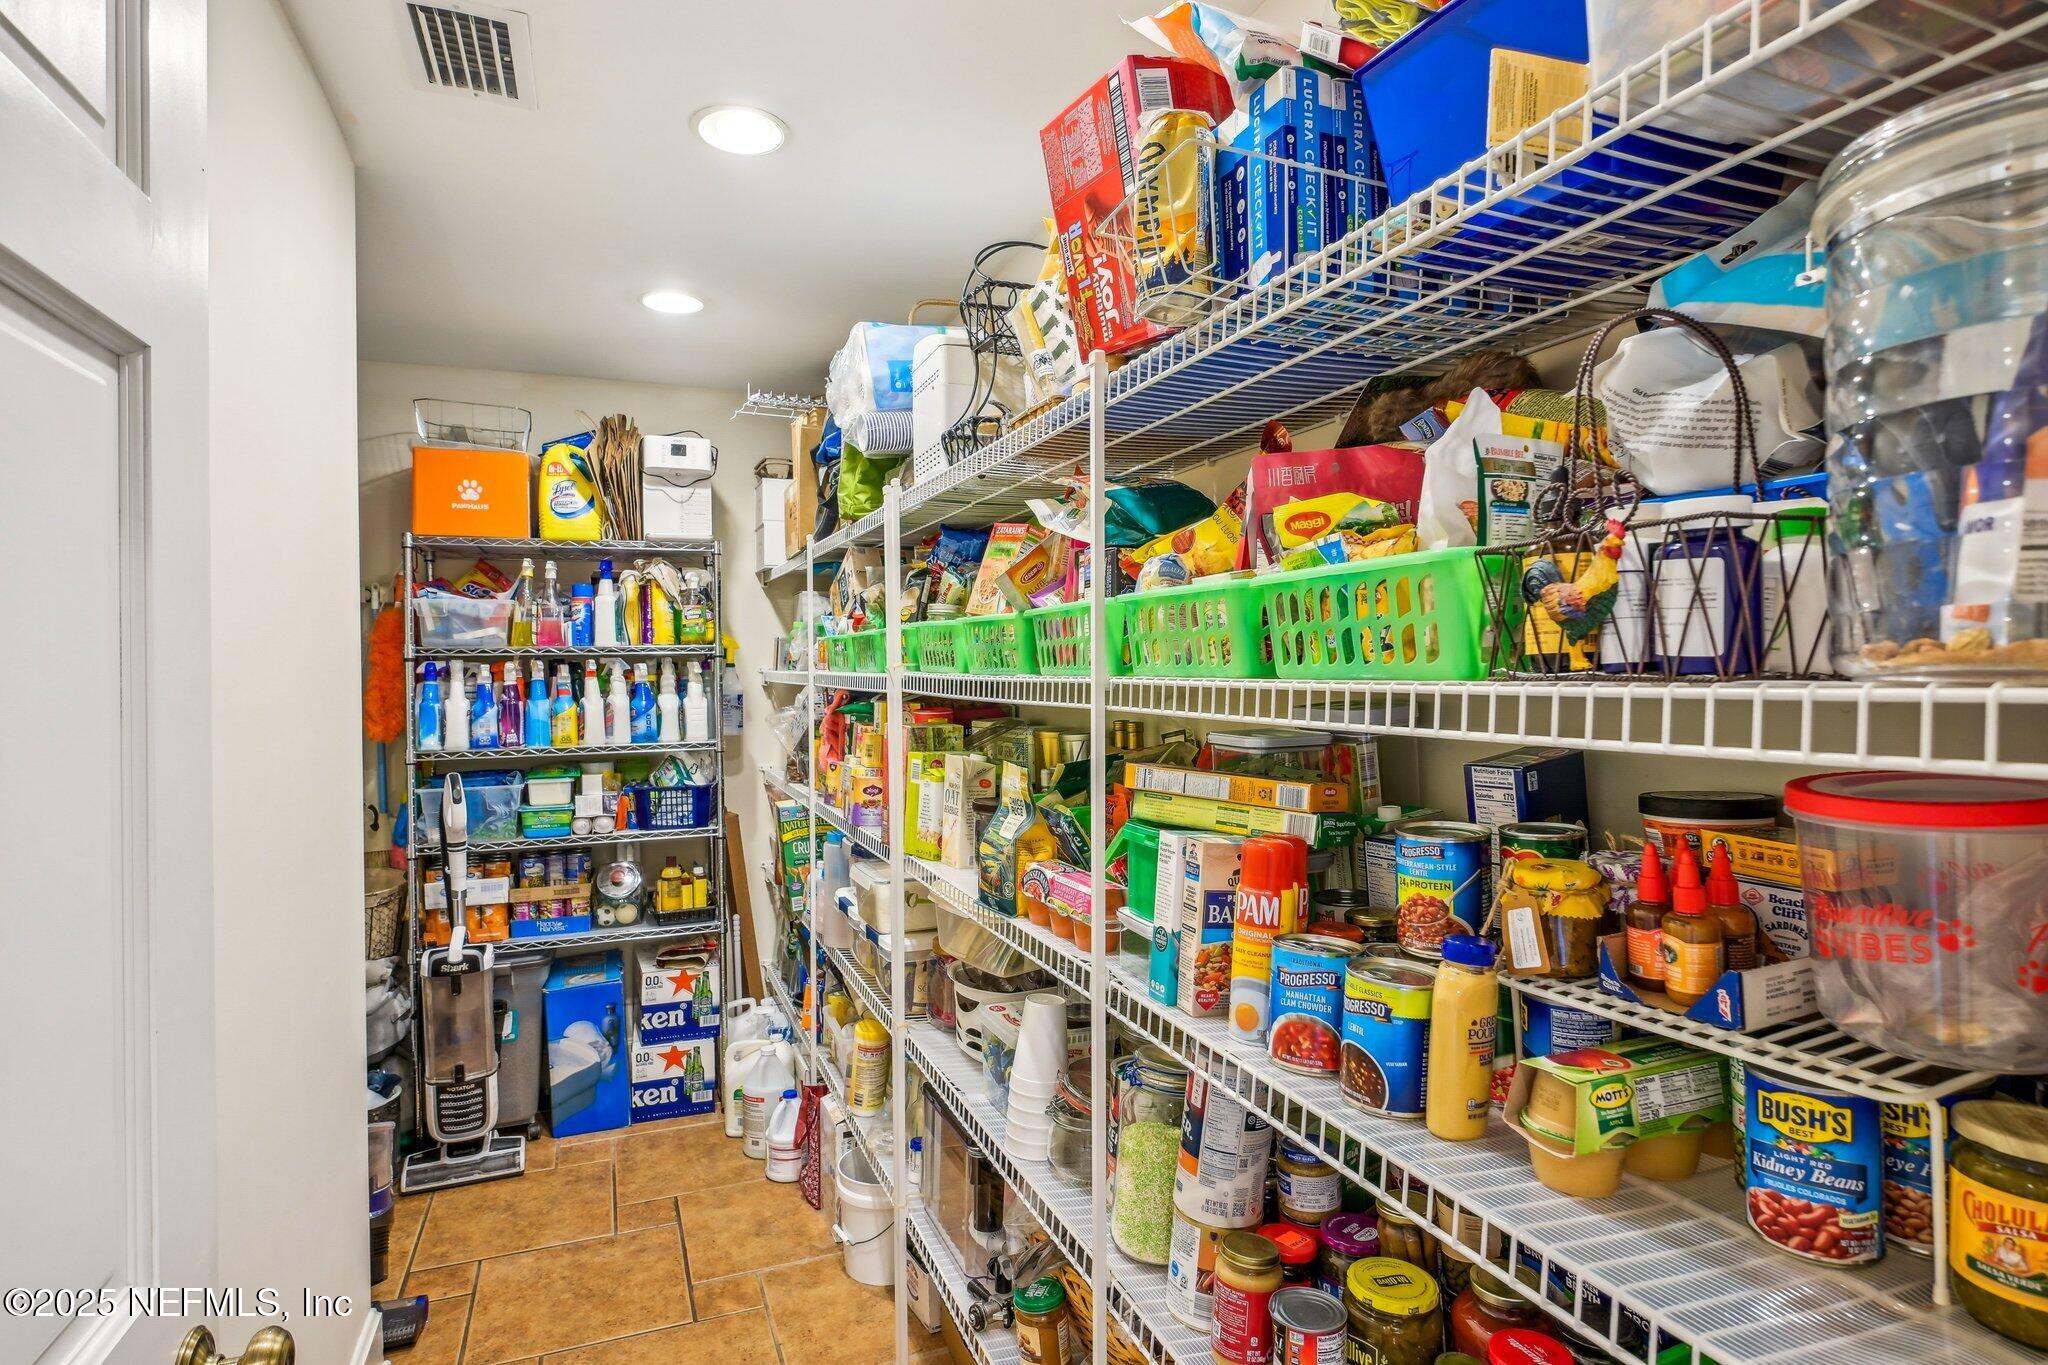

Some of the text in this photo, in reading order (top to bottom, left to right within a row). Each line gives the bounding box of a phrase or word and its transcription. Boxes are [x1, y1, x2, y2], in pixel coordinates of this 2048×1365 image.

[1303, 78, 1314, 141] LUCIRA
[1352, 89, 1364, 151] LUCIRA
[552, 482, 576, 496] Lysol
[451, 502, 490, 511] PAWHAUS
[1473, 767, 1496, 775] Nutrition
[945, 788, 960, 806] OAT
[1503, 793, 1515, 801] 170
[1401, 846, 1440, 857] PROGRESSO
[1410, 880, 1451, 891] PROTEIN
[1236, 891, 1280, 927] PAM
[1238, 927, 1273, 940] ORIGINAL
[1764, 921, 1808, 940] SARDINES
[1773, 940, 1802, 951] USTARD
[441, 963, 469, 972] Shark
[1290, 958, 1323, 968] TRADITIONAL
[1280, 972, 1336, 987] PROGRESSO
[1285, 989, 1326, 1004] MANHATTAN
[1358, 986, 1383, 999] CLASSICS
[1280, 998, 1332, 1014] CLAM CHOWDER
[1348, 1021, 1365, 1036] LENTIL
[1634, 1077, 1656, 1085] Nutrition
[1596, 1088, 1629, 1103] MOTT'S
[1651, 1110, 1660, 1119] 50
[1761, 1095, 1848, 1136] BUSH'S
[1789, 1127, 1814, 1139] BEST
[1773, 1150, 1832, 1171] LIGHT RED
[1752, 1150, 1865, 1192] Kidney Beans
[1798, 1185, 1847, 1205] COLORADOS
[1963, 1190, 2048, 1232] CHOLUL
[1841, 1215, 1870, 1224] VEGETARIAN
[1995, 1226, 2038, 1240] SALSA
[1318, 1336, 1336, 1344] Nutrition
